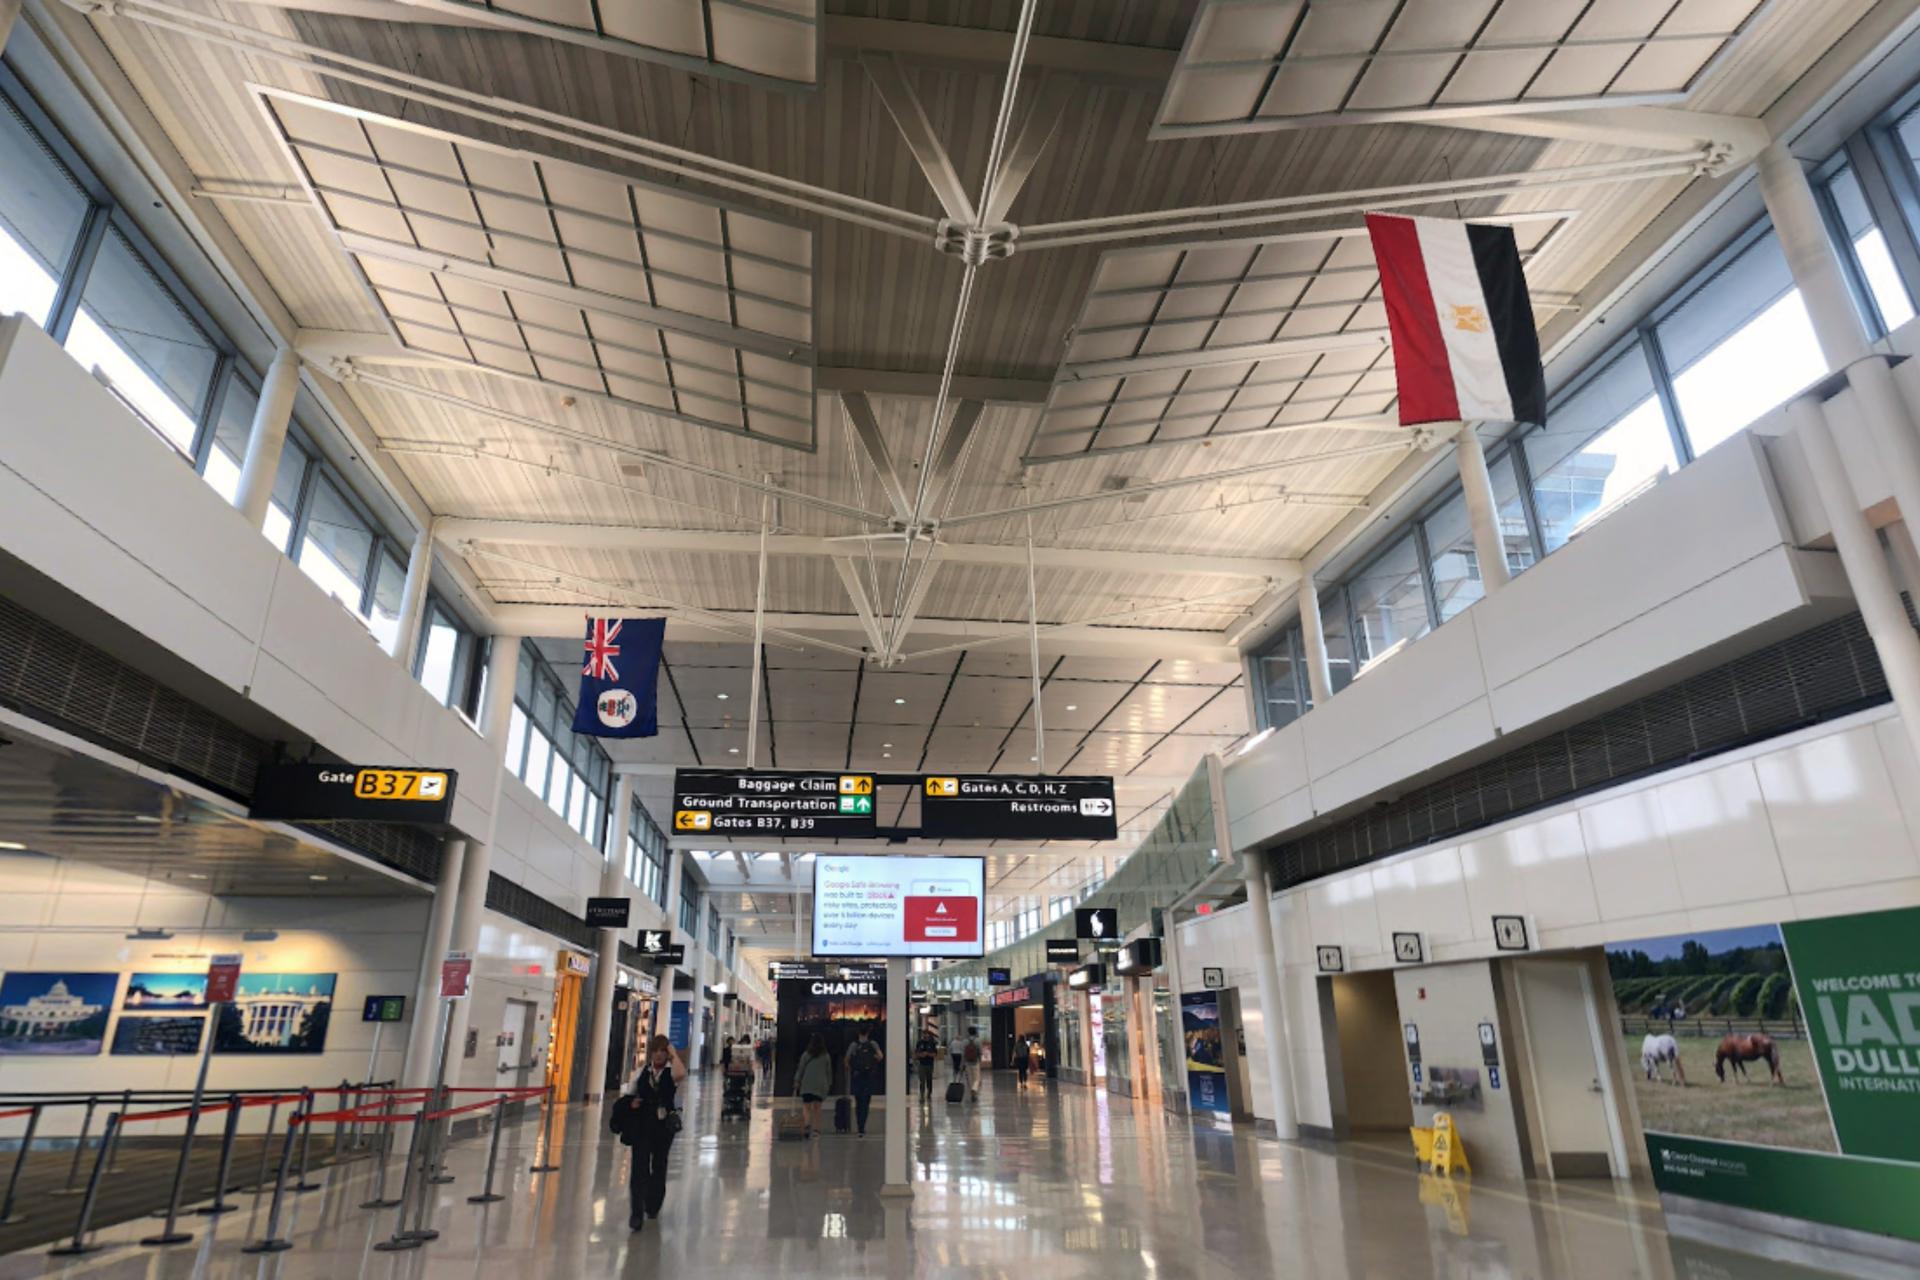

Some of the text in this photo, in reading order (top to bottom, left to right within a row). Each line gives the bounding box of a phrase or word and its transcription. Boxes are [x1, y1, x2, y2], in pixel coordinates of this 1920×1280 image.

[318, 770, 417, 796] Gate B37
[738, 779, 837, 792] Baggage Claim
[961, 783, 1067, 796] Gates A, C, D, H, Z
[682, 796, 837, 811] Ground Transportation
[1011, 802, 1078, 813] Restrooms
[713, 816, 815, 830] Gates B37, B39
[824, 864, 850, 873] Google
[811, 983, 878, 995] CHANEL
[1812, 974, 1901, 992] WELCOME
[1831, 1048, 1920, 1075] DULL
